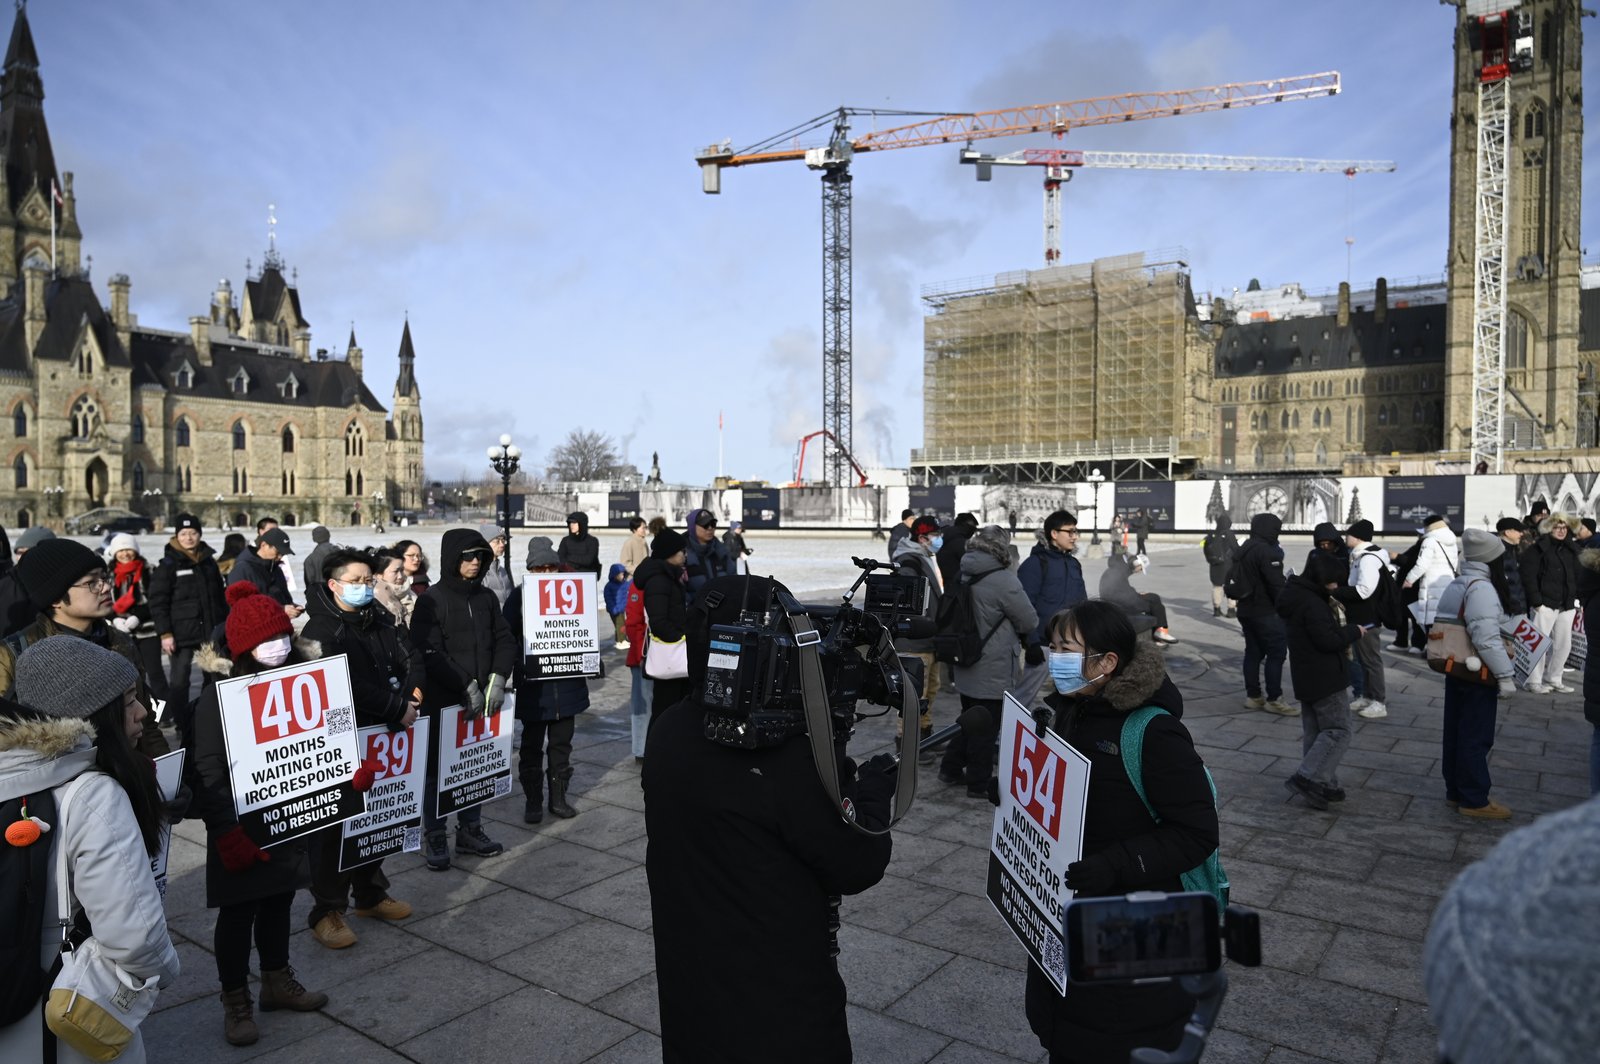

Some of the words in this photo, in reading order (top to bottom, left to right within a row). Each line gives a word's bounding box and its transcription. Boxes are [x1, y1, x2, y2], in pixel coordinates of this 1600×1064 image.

[545, 579, 578, 615] 19
[535, 630, 570, 639] WAITING
[573, 629, 588, 637] FOR
[545, 619, 579, 628] MONTHS
[531, 642, 549, 650] IRCC
[551, 640, 594, 649] RESPONSE
[1516, 624, 1539, 652] 22
[539, 657, 549, 665] NO
[550, 655, 582, 664] TIMELINE
[554, 664, 583, 672] RESULTS
[261, 673, 321, 736] 40
[265, 736, 325, 764] MONTHS
[373, 730, 408, 780] 39
[450, 756, 484, 773] WAITING
[487, 750, 502, 761] FOR
[460, 742, 494, 760] MONTHS
[252, 757, 312, 785] WAITING
[316, 748, 342, 766] FOR
[445, 773, 463, 786] IRCC
[465, 759, 506, 780] RESPONSE
[1016, 728, 1058, 831] 54
[245, 784, 278, 805] IRCC
[280, 761, 352, 795] RESPONSE
[368, 780, 406, 799] MONTHS
[452, 789, 462, 798] NO
[455, 797, 465, 806] NO
[466, 786, 495, 802] RESULTS
[263, 809, 280, 823] NO
[283, 789, 342, 816] TIMELINES
[367, 797, 395, 813] AITING
[397, 792, 414, 805] FOR
[270, 821, 287, 835] NO
[290, 804, 339, 829] RESULTS
[350, 816, 371, 831] IRCC
[372, 803, 417, 825] RESPONSE
[357, 836, 368, 847] NO
[1012, 806, 1050, 859] MONTHS
[360, 846, 371, 858] NO
[373, 837, 403, 855] RESULTS
[1003, 817, 1037, 872] WAITING
[1040, 864, 1060, 895] FOR
[996, 833, 1014, 866] IRCC
[1014, 855, 1063, 925] RESPONSE
[1001, 872, 1009, 890] NO
[1011, 886, 1044, 936] TIMELINE
[1002, 896, 1011, 913] NO
[1012, 908, 1044, 954] RESULTS
